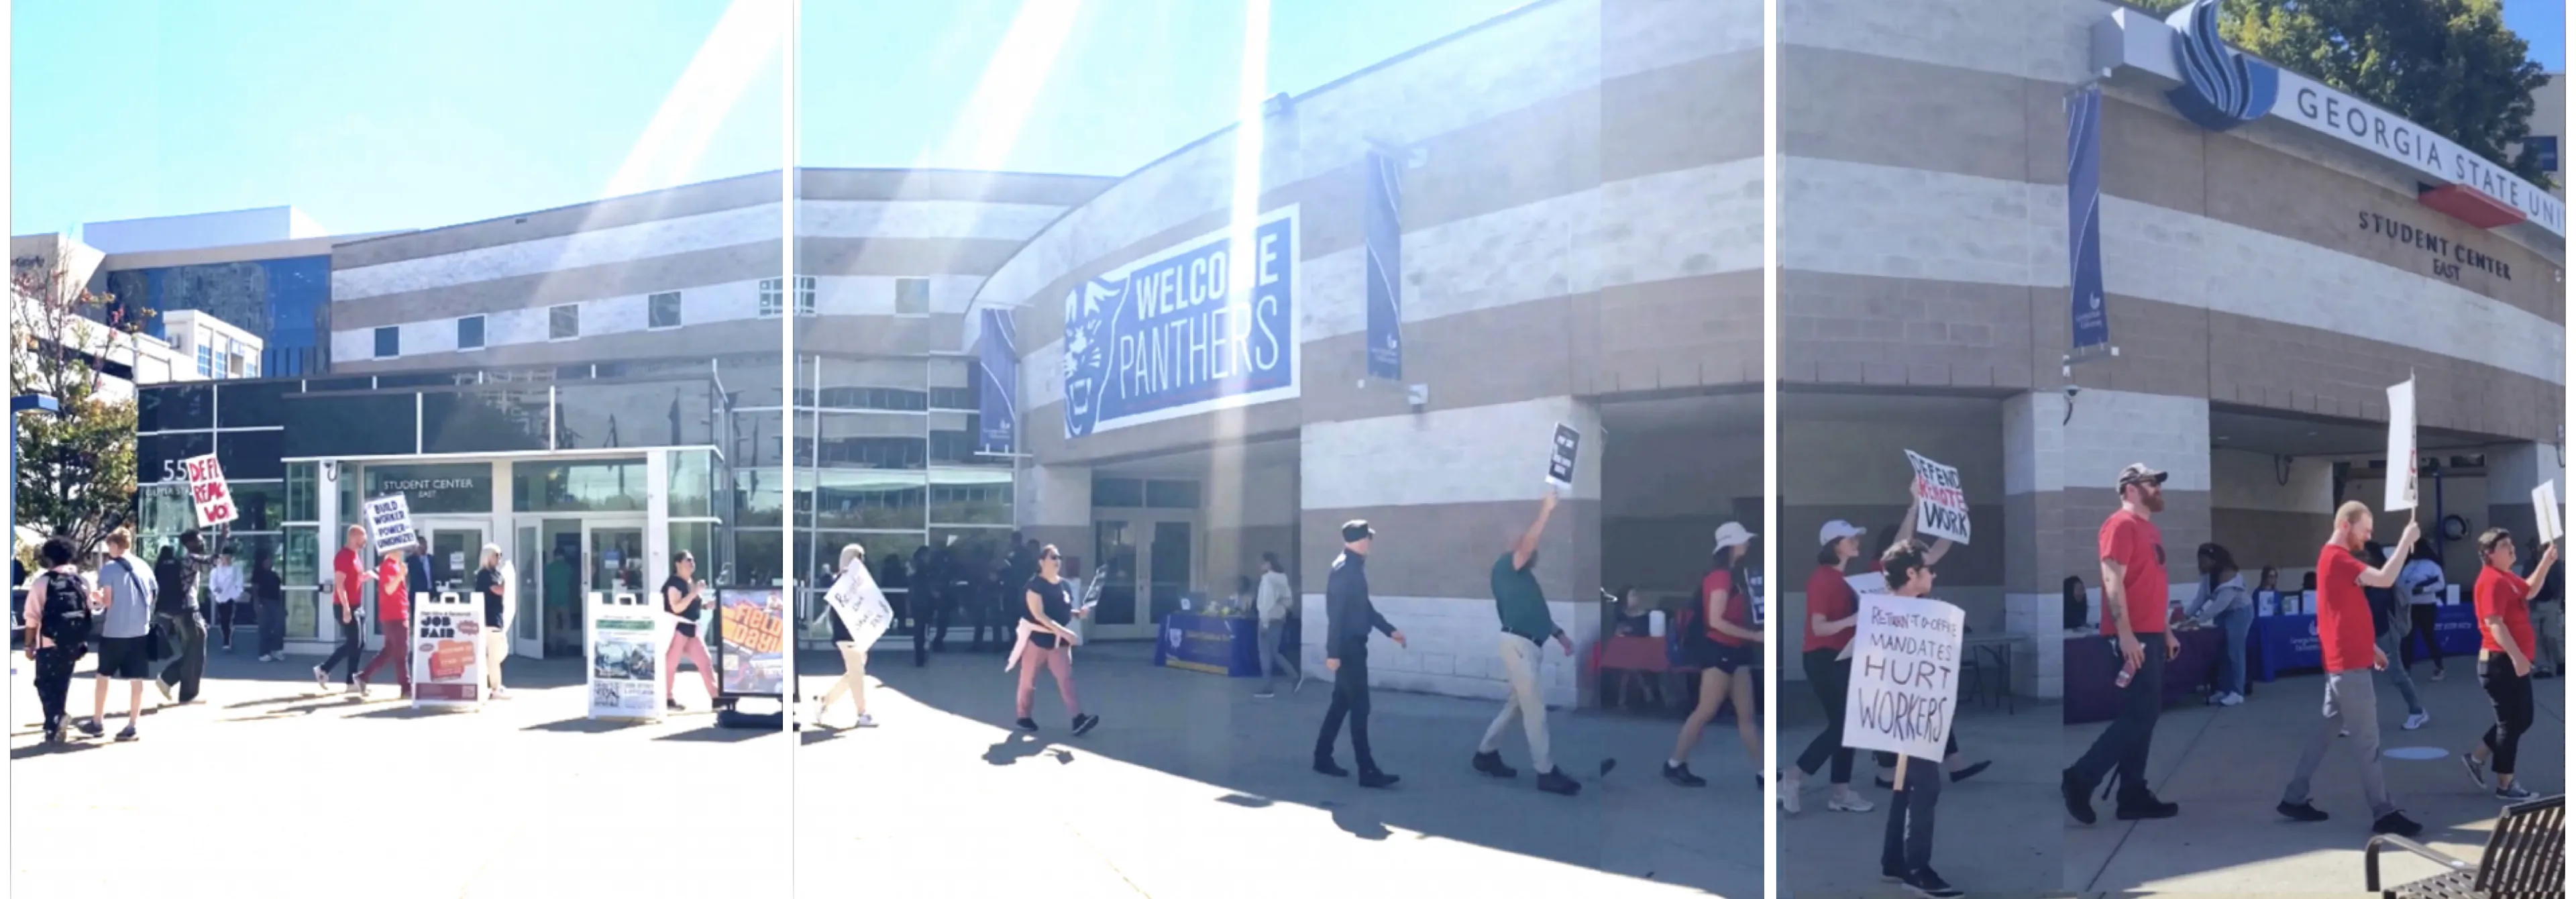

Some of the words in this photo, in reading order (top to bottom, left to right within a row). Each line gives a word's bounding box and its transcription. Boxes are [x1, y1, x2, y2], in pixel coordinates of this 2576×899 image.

[2296, 87, 2442, 172] GEORGIA
[2455, 154, 2519, 207] STATE
[2358, 210, 2449, 258] STUDENT
[2454, 244, 2512, 282] CENTER
[1135, 233, 1279, 322] WELCOE
[2432, 258, 2462, 282] EAST
[1119, 294, 1279, 400] PANTHERS
[383, 479, 430, 490] STUDENT
[432, 478, 474, 490] CENTER
[417, 490, 437, 498] EAST
[373, 510, 405, 525] WORKER
[374, 500, 398, 515] BUILD
[1923, 500, 1968, 538] WORK
[420, 616, 451, 627] JOB
[420, 627, 455, 638] FAIR
[1870, 633, 1953, 662] MANDATES
[1864, 655, 1951, 690] HURT
[1858, 687, 1948, 743] WORKERS
